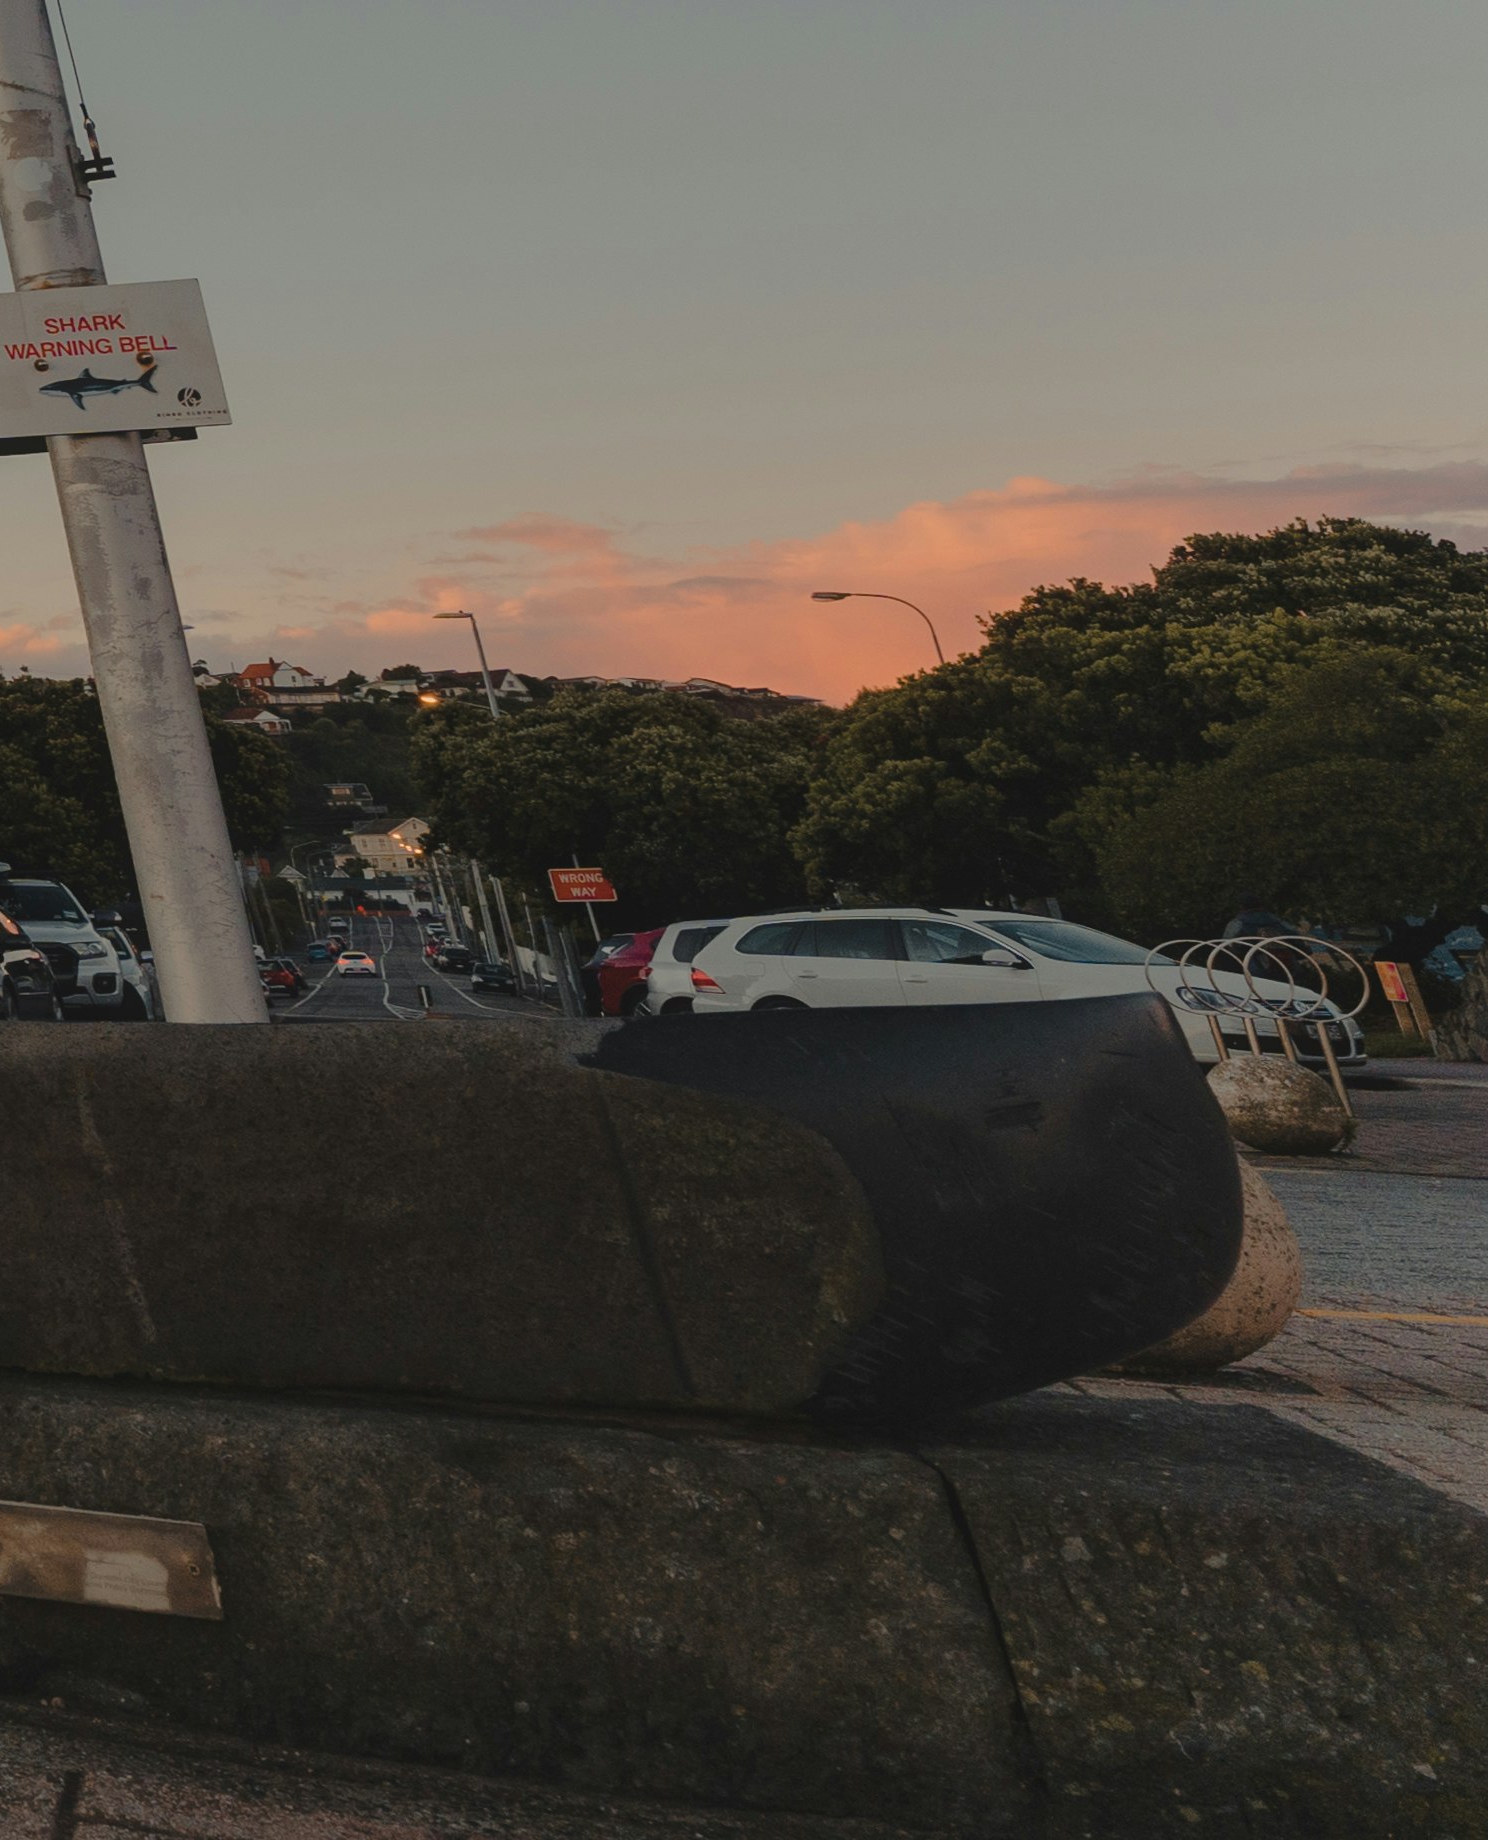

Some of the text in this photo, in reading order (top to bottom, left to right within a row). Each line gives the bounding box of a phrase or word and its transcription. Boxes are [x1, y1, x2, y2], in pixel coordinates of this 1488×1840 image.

[44, 314, 126, 334] SHARK
[4, 335, 178, 360] WARNING BELL
[557, 872, 604, 884] WRONG
[569, 886, 597, 897] WAY
